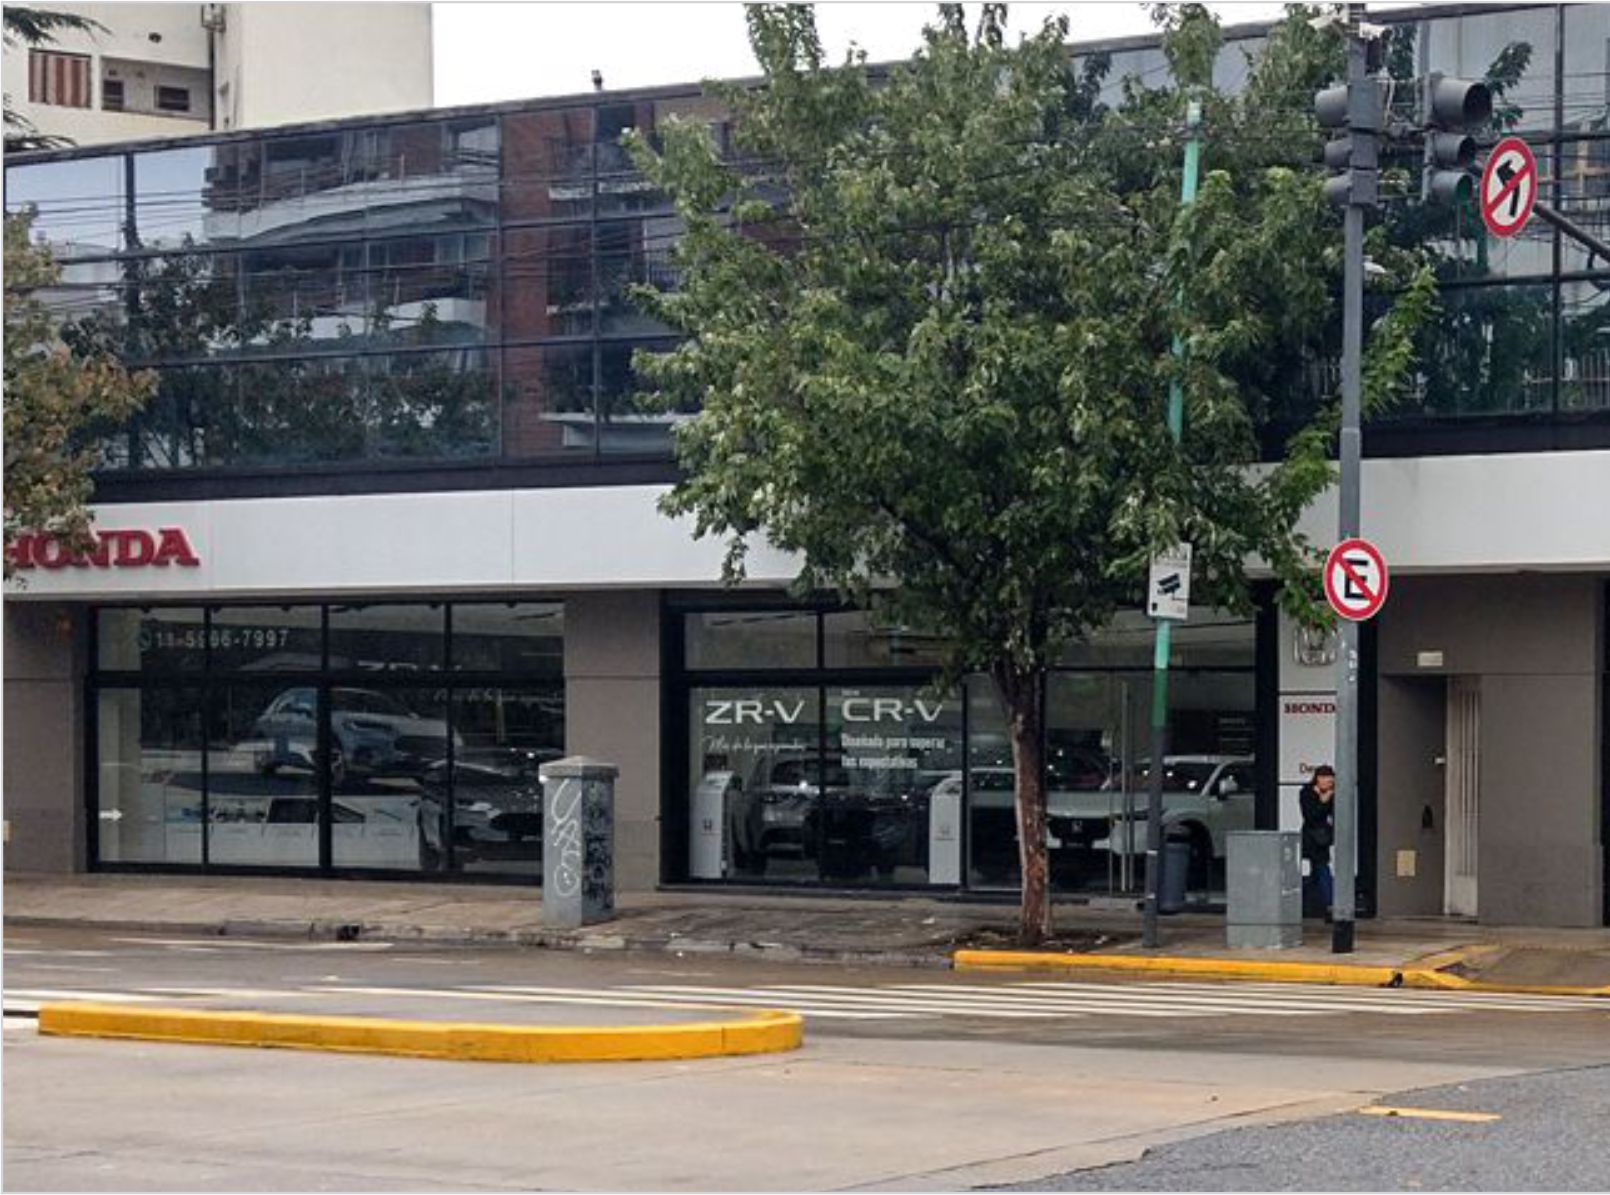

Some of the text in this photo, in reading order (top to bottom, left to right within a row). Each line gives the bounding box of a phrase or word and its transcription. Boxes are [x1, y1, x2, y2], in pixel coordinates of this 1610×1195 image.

[705, 700, 805, 724] ZR-V
[842, 698, 943, 722] CR-V
[1284, 703, 1336, 714] HOND
